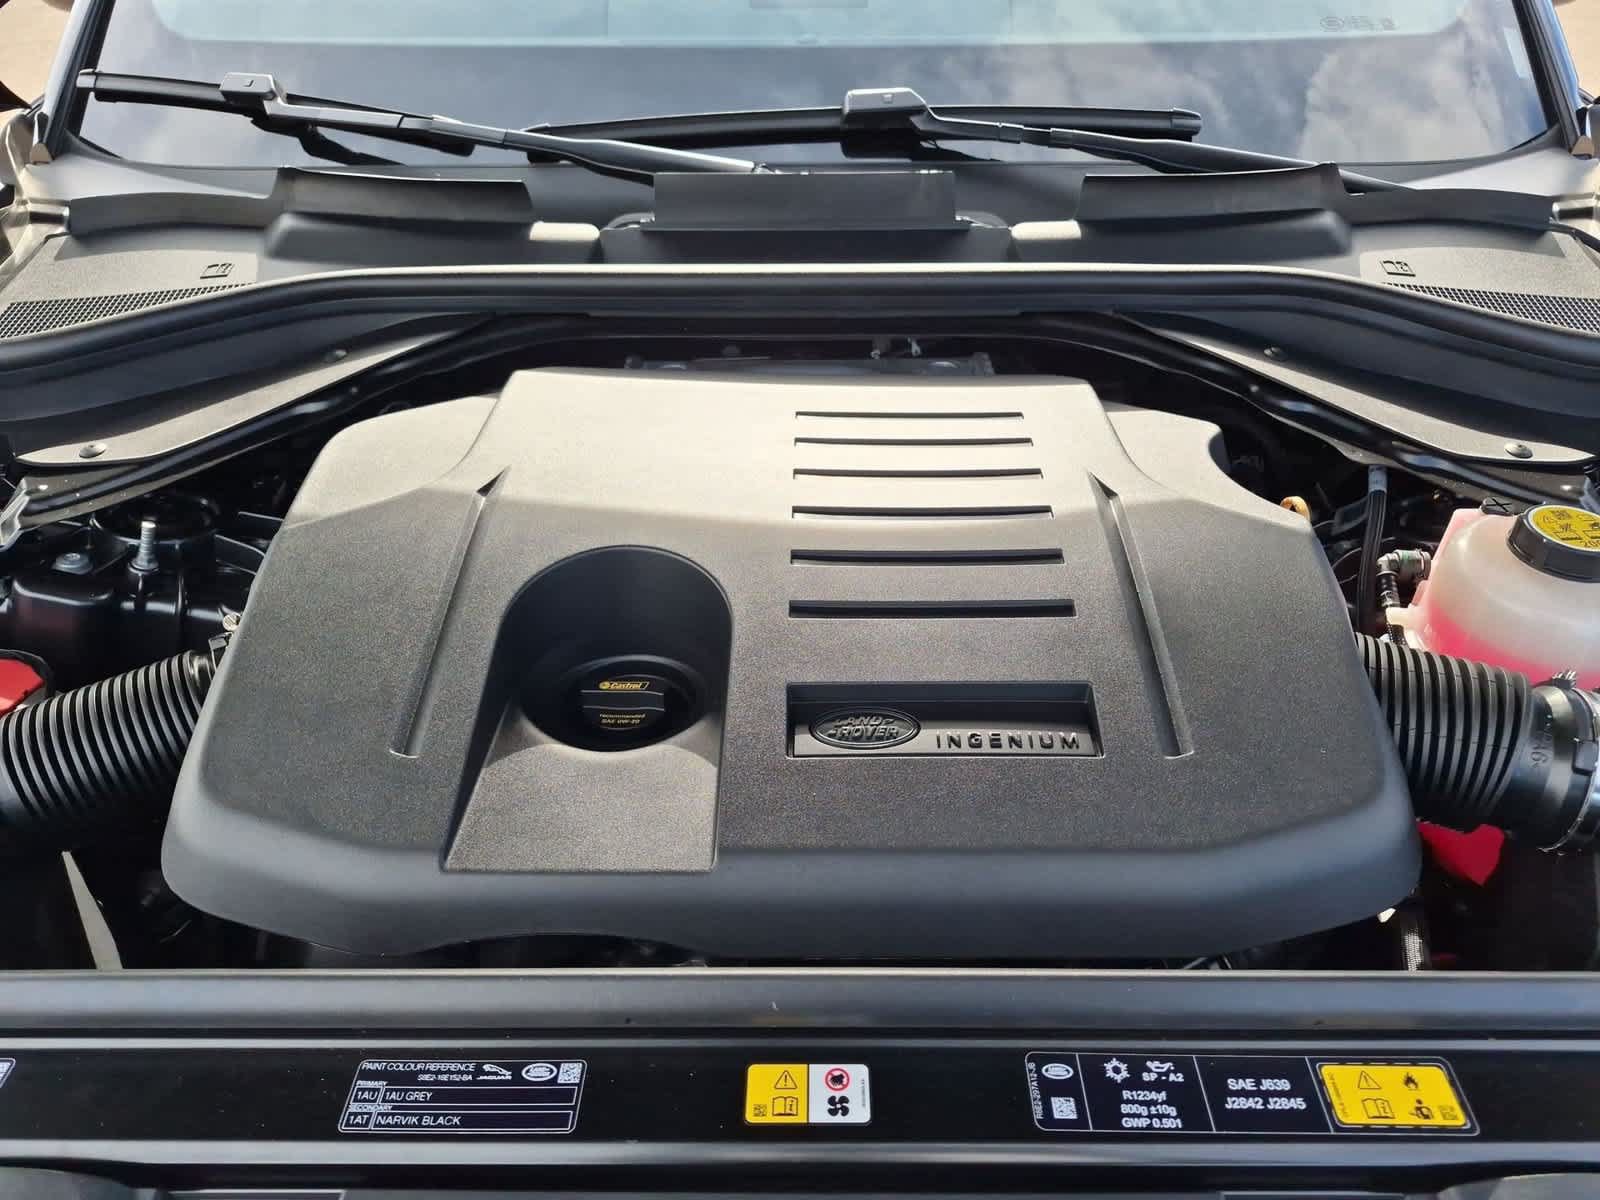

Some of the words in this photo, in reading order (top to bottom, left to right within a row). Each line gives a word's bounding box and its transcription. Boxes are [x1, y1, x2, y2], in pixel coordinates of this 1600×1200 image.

[610, 682, 642, 691] Castrol
[935, 731, 1080, 749] INGENIUM
[362, 1063, 387, 1071] PAINT
[387, 1063, 425, 1071] COLOUR
[425, 1063, 476, 1071] REFERENCE
[1142, 1072, 1158, 1081] SP
[1168, 1072, 1184, 1082] A2
[1227, 1078, 1257, 1091] SAE
[1259, 1079, 1291, 1091] J639
[357, 1091, 378, 1100] 1AU
[385, 1091, 404, 1101] 1AU
[405, 1091, 432, 1101] GREY
[1122, 1090, 1167, 1102] R1234yf
[1225, 1097, 1264, 1109] J2842
[1266, 1097, 1307, 1110] J2845
[1121, 1104, 1148, 1116] 800g
[349, 1115, 369, 1124] 1AT
[375, 1115, 419, 1125] NARVIK
[421, 1115, 461, 1126] BLACK
[1122, 1117, 1151, 1128] GWP
[1152, 1118, 1182, 1129] 0.501
